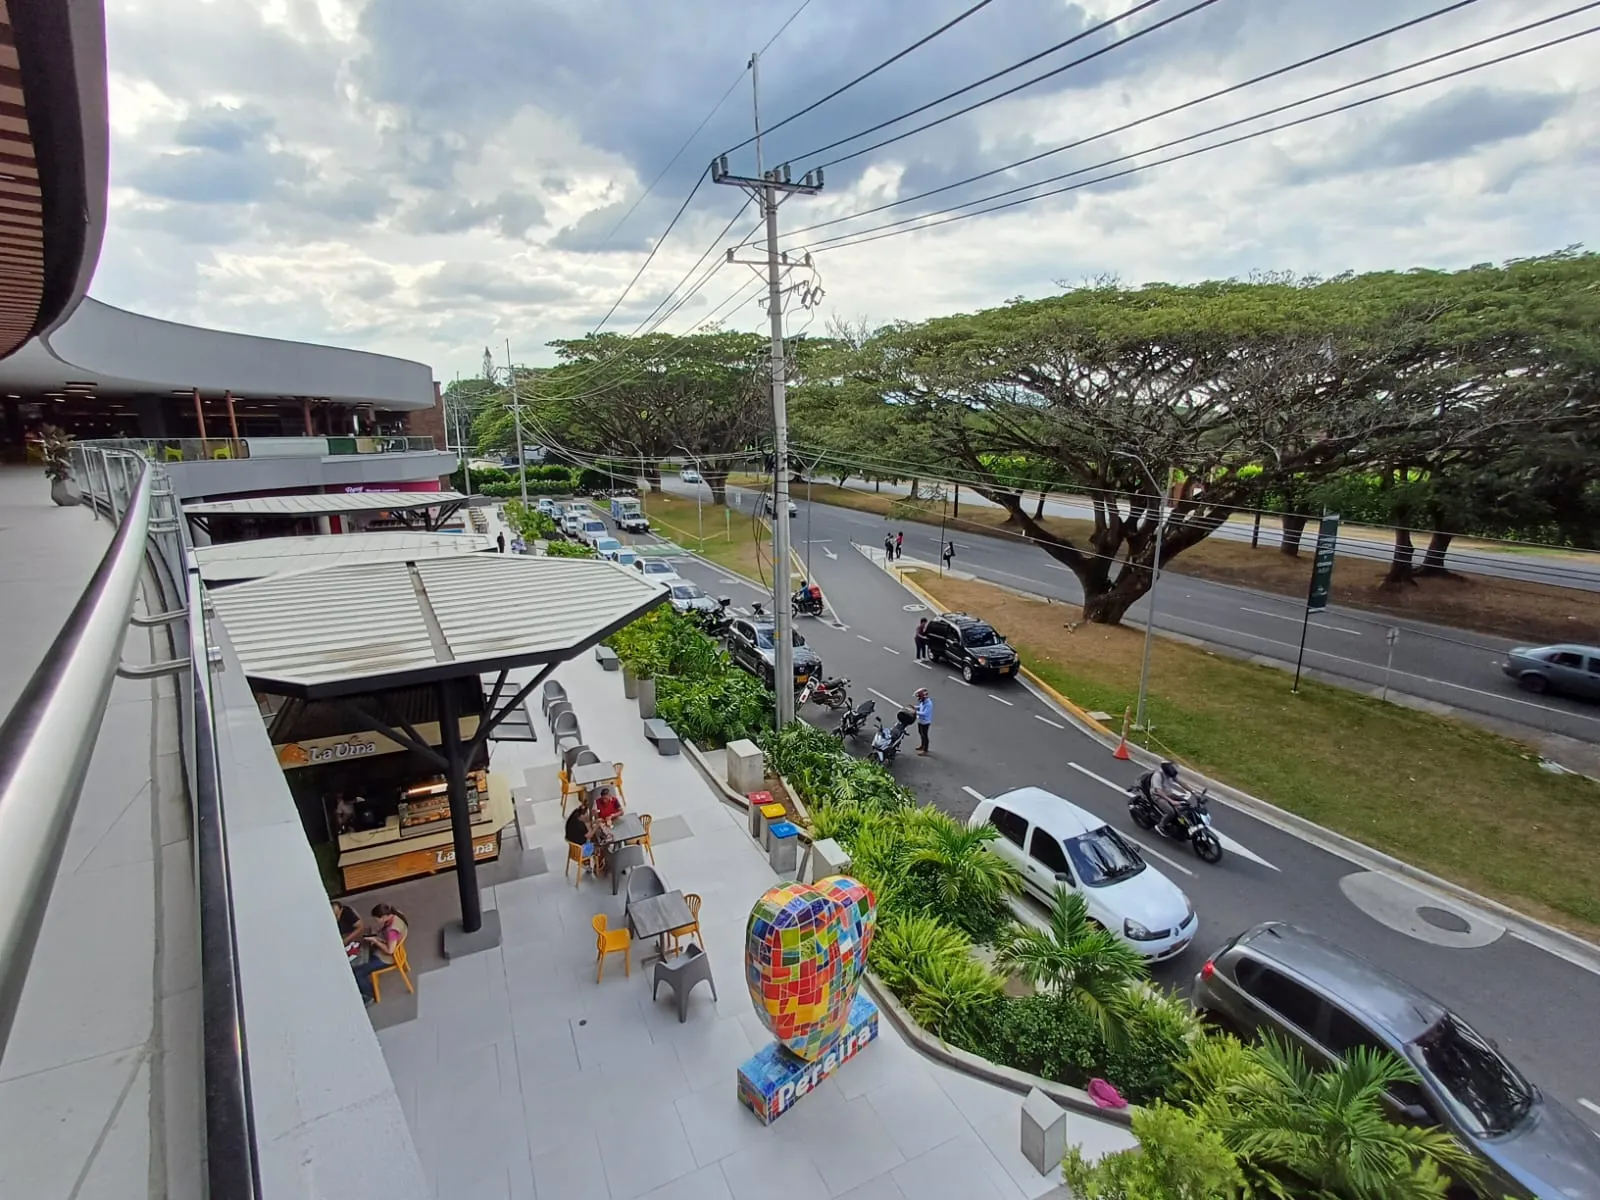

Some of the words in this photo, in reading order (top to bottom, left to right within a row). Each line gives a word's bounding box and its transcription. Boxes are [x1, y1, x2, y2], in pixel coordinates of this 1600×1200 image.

[309, 746, 333, 761] La
[435, 850, 455, 863] La
[778, 1025, 871, 1112] Pereira
